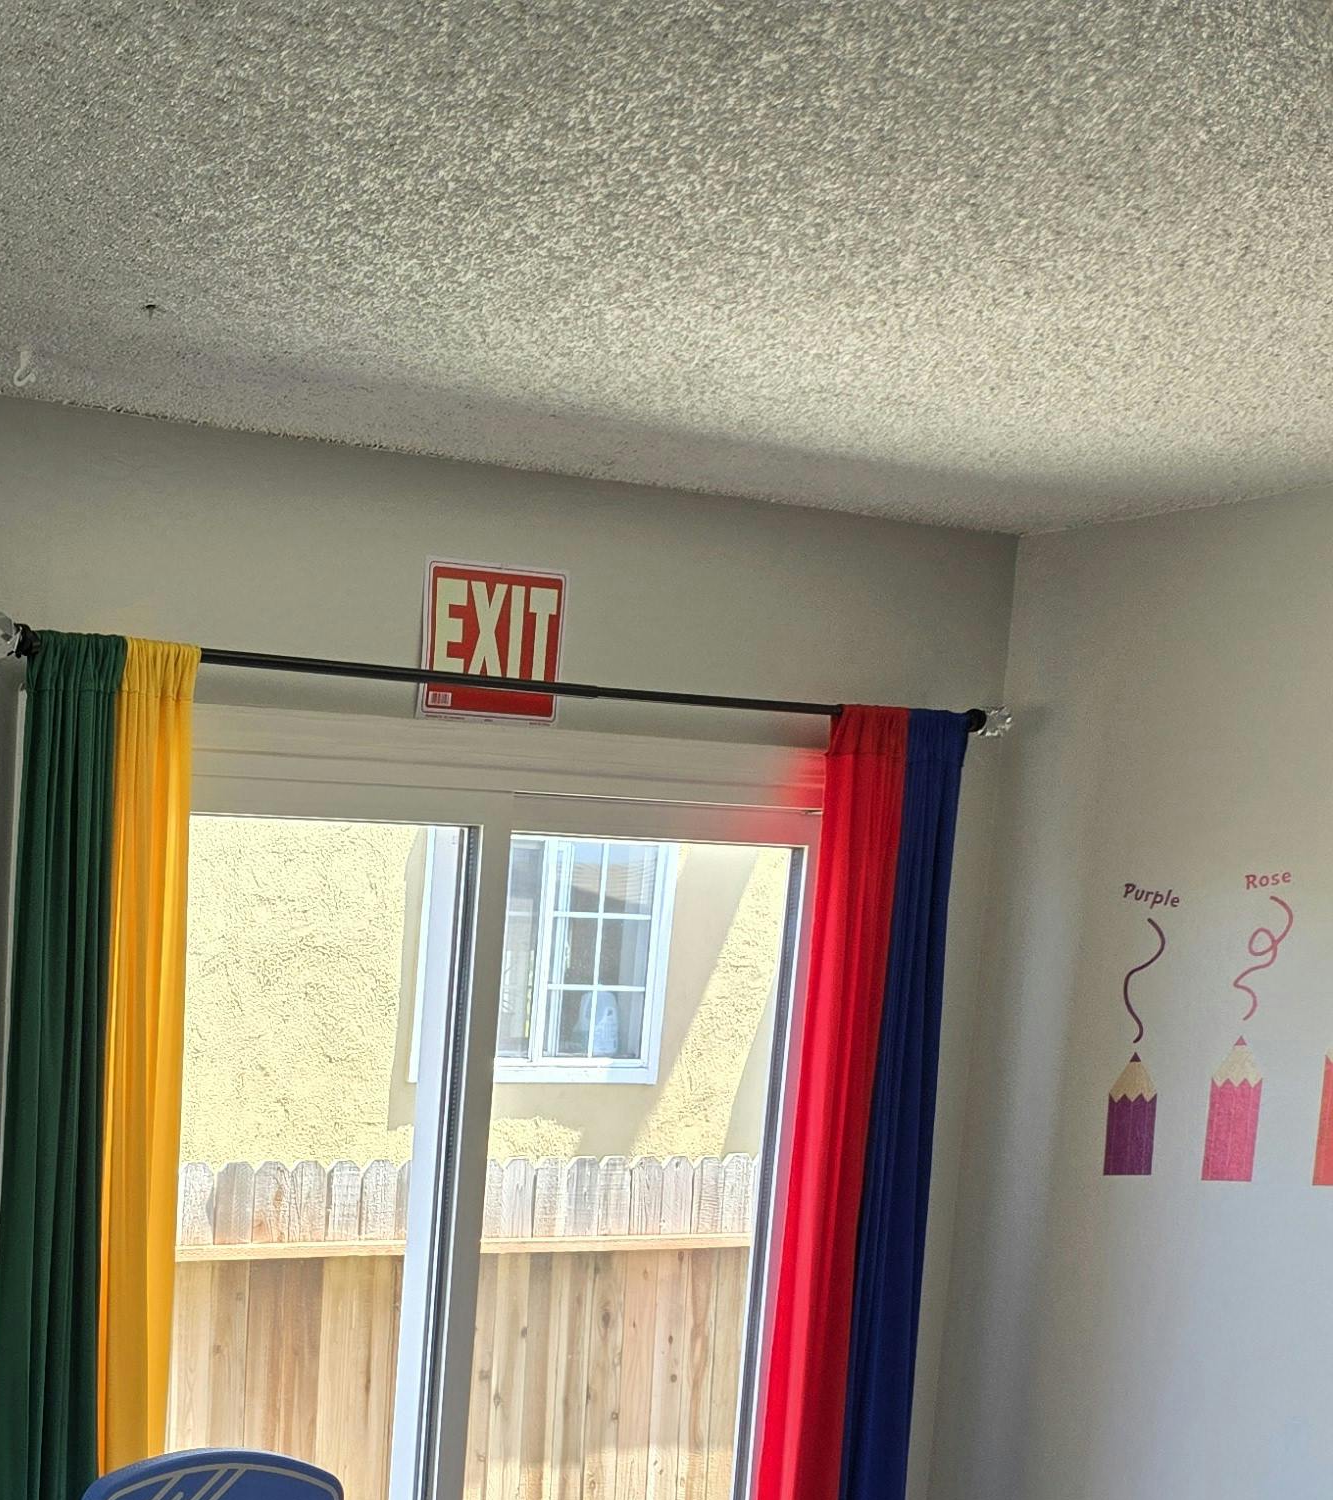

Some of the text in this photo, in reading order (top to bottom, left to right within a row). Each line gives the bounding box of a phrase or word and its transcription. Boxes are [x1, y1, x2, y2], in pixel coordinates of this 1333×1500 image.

[433, 577, 559, 683] EXIT
[1244, 869, 1292, 890] Rose
[1122, 883, 1181, 909] Purple
